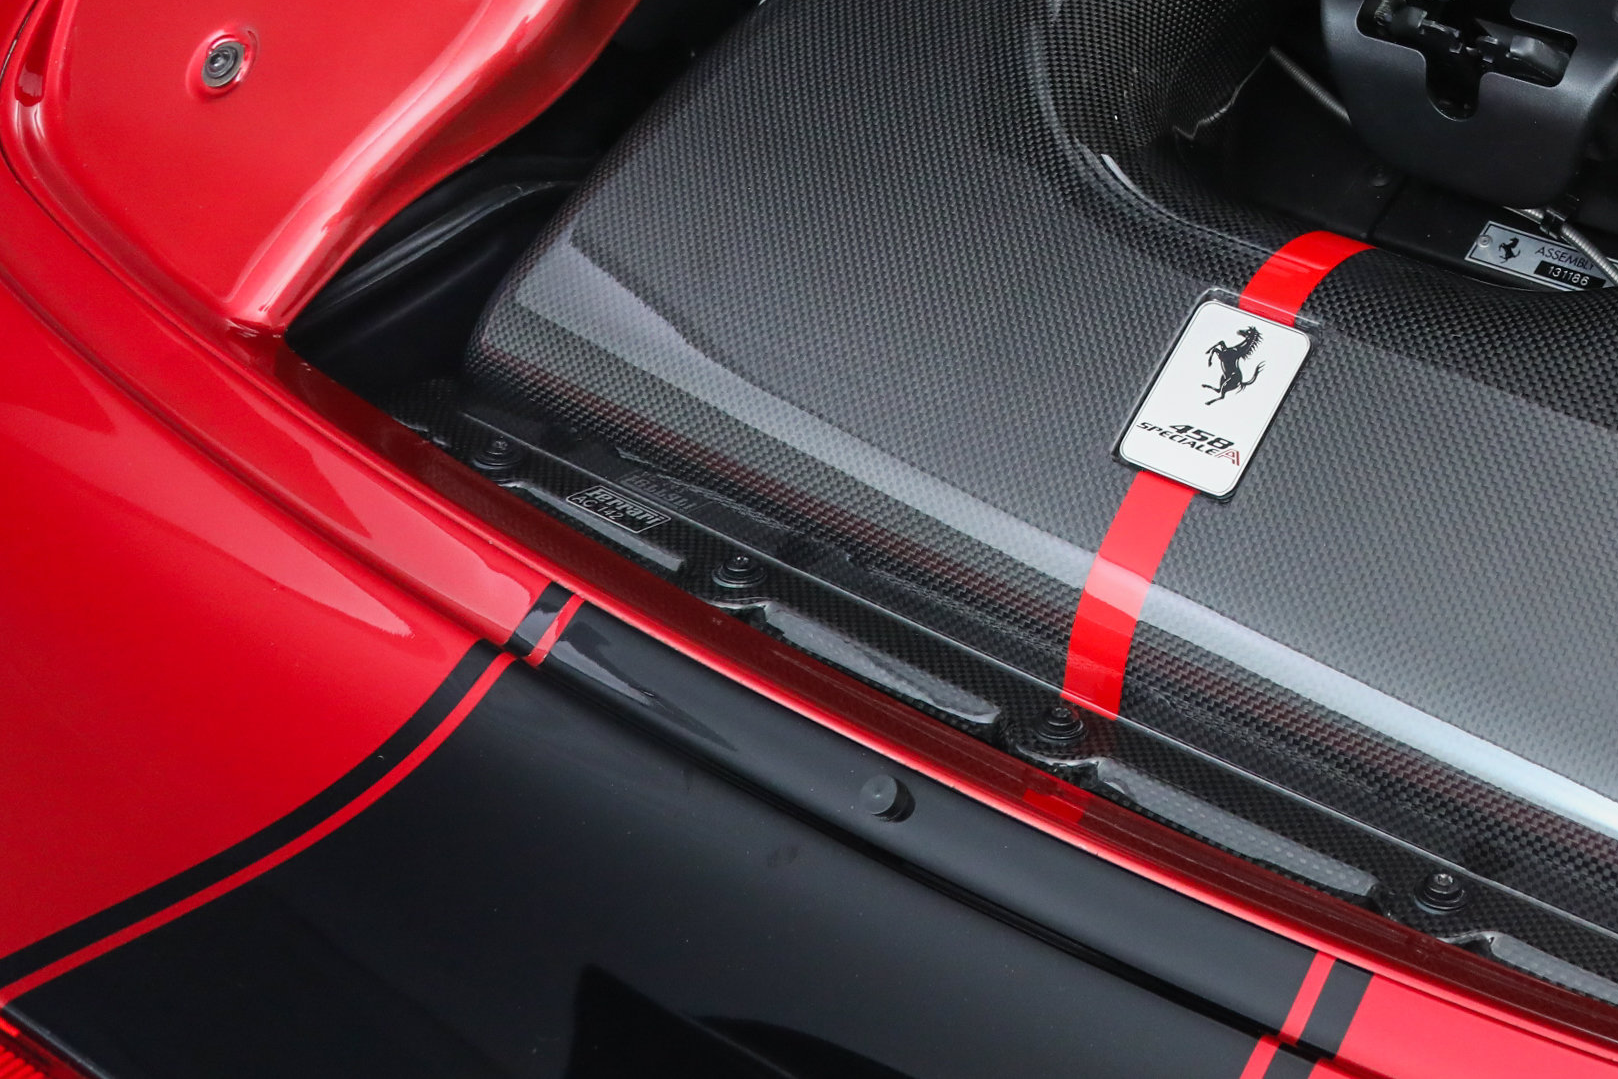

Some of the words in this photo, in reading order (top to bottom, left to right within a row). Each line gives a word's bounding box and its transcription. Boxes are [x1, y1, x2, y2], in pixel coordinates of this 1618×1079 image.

[1548, 266, 1589, 286] 131186
[1169, 424, 1234, 449] 458
[573, 496, 597, 507] AC
[597, 507, 624, 520] 142
[585, 489, 665, 524] Ferrari
